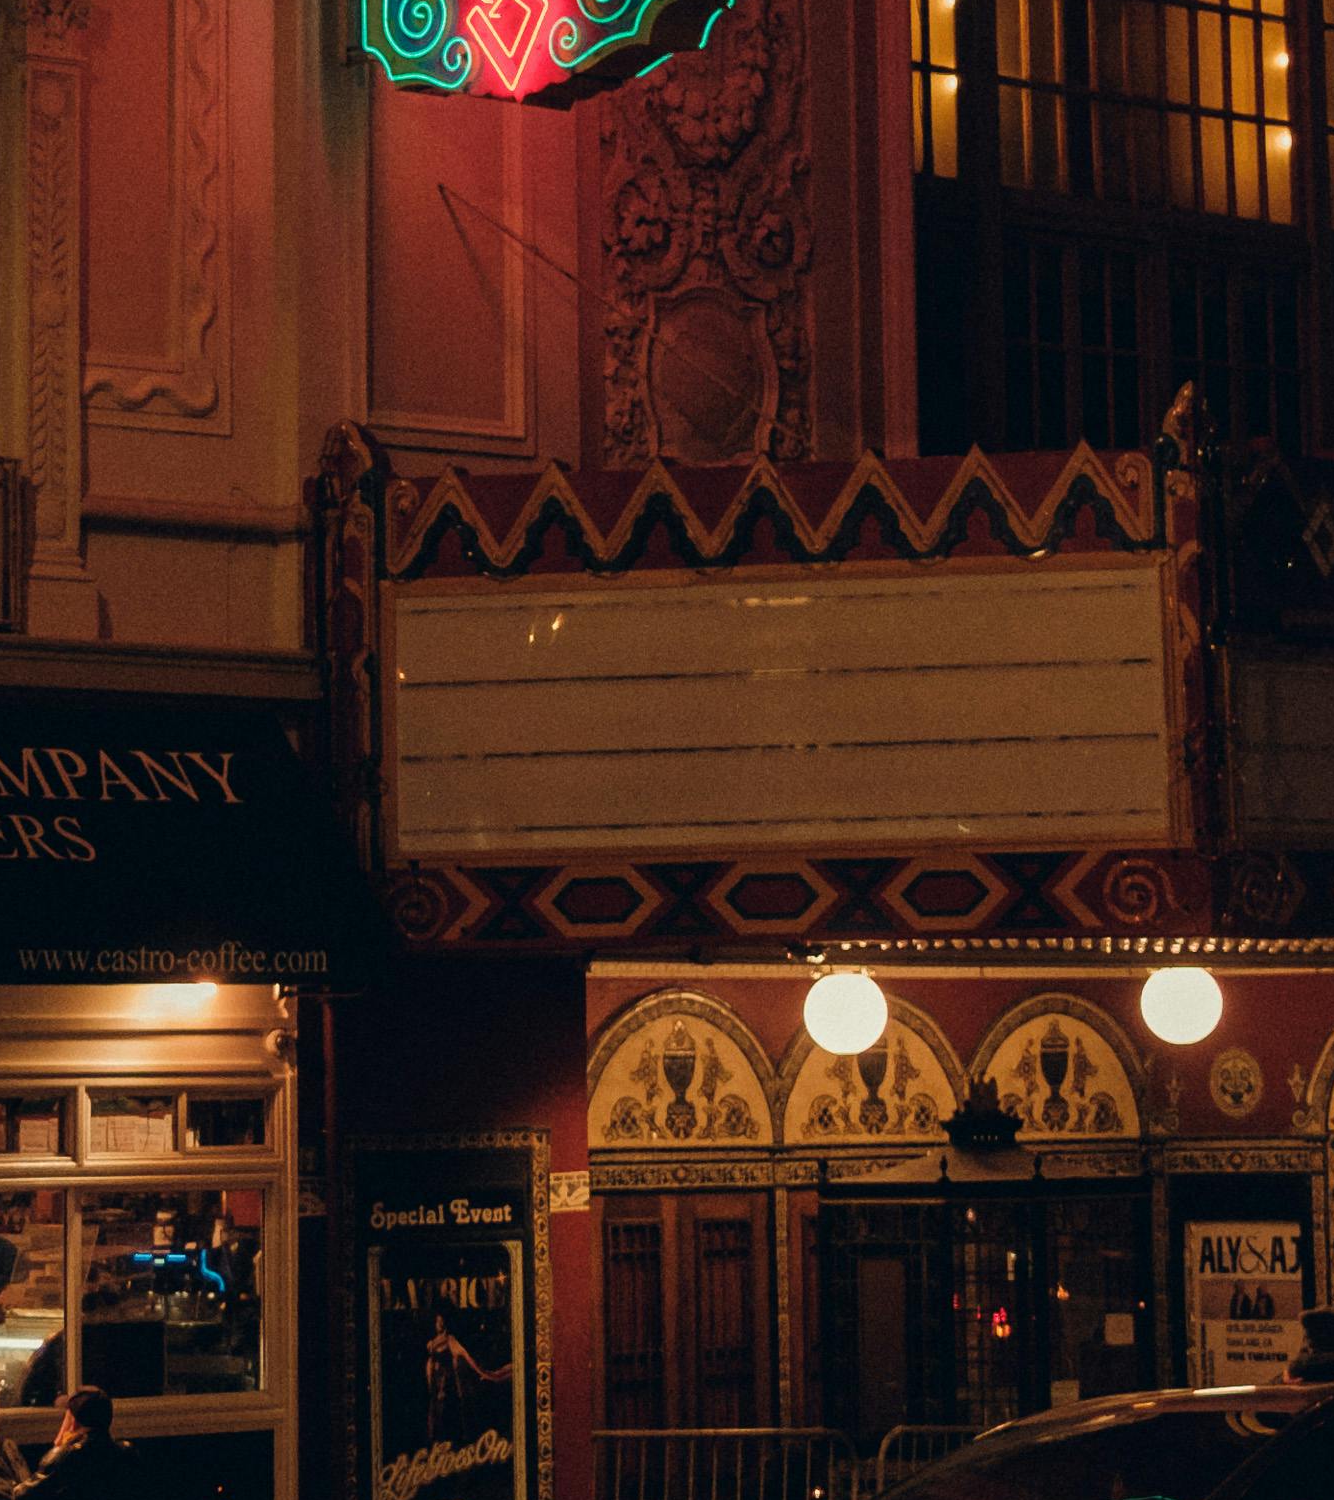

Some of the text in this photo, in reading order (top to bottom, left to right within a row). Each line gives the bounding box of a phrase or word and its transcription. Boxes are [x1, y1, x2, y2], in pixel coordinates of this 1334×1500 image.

[18, 941, 330, 975] www.castro-coffee.com
[370, 1198, 513, 1231] Special Event
[475, 1427, 514, 1464] On
